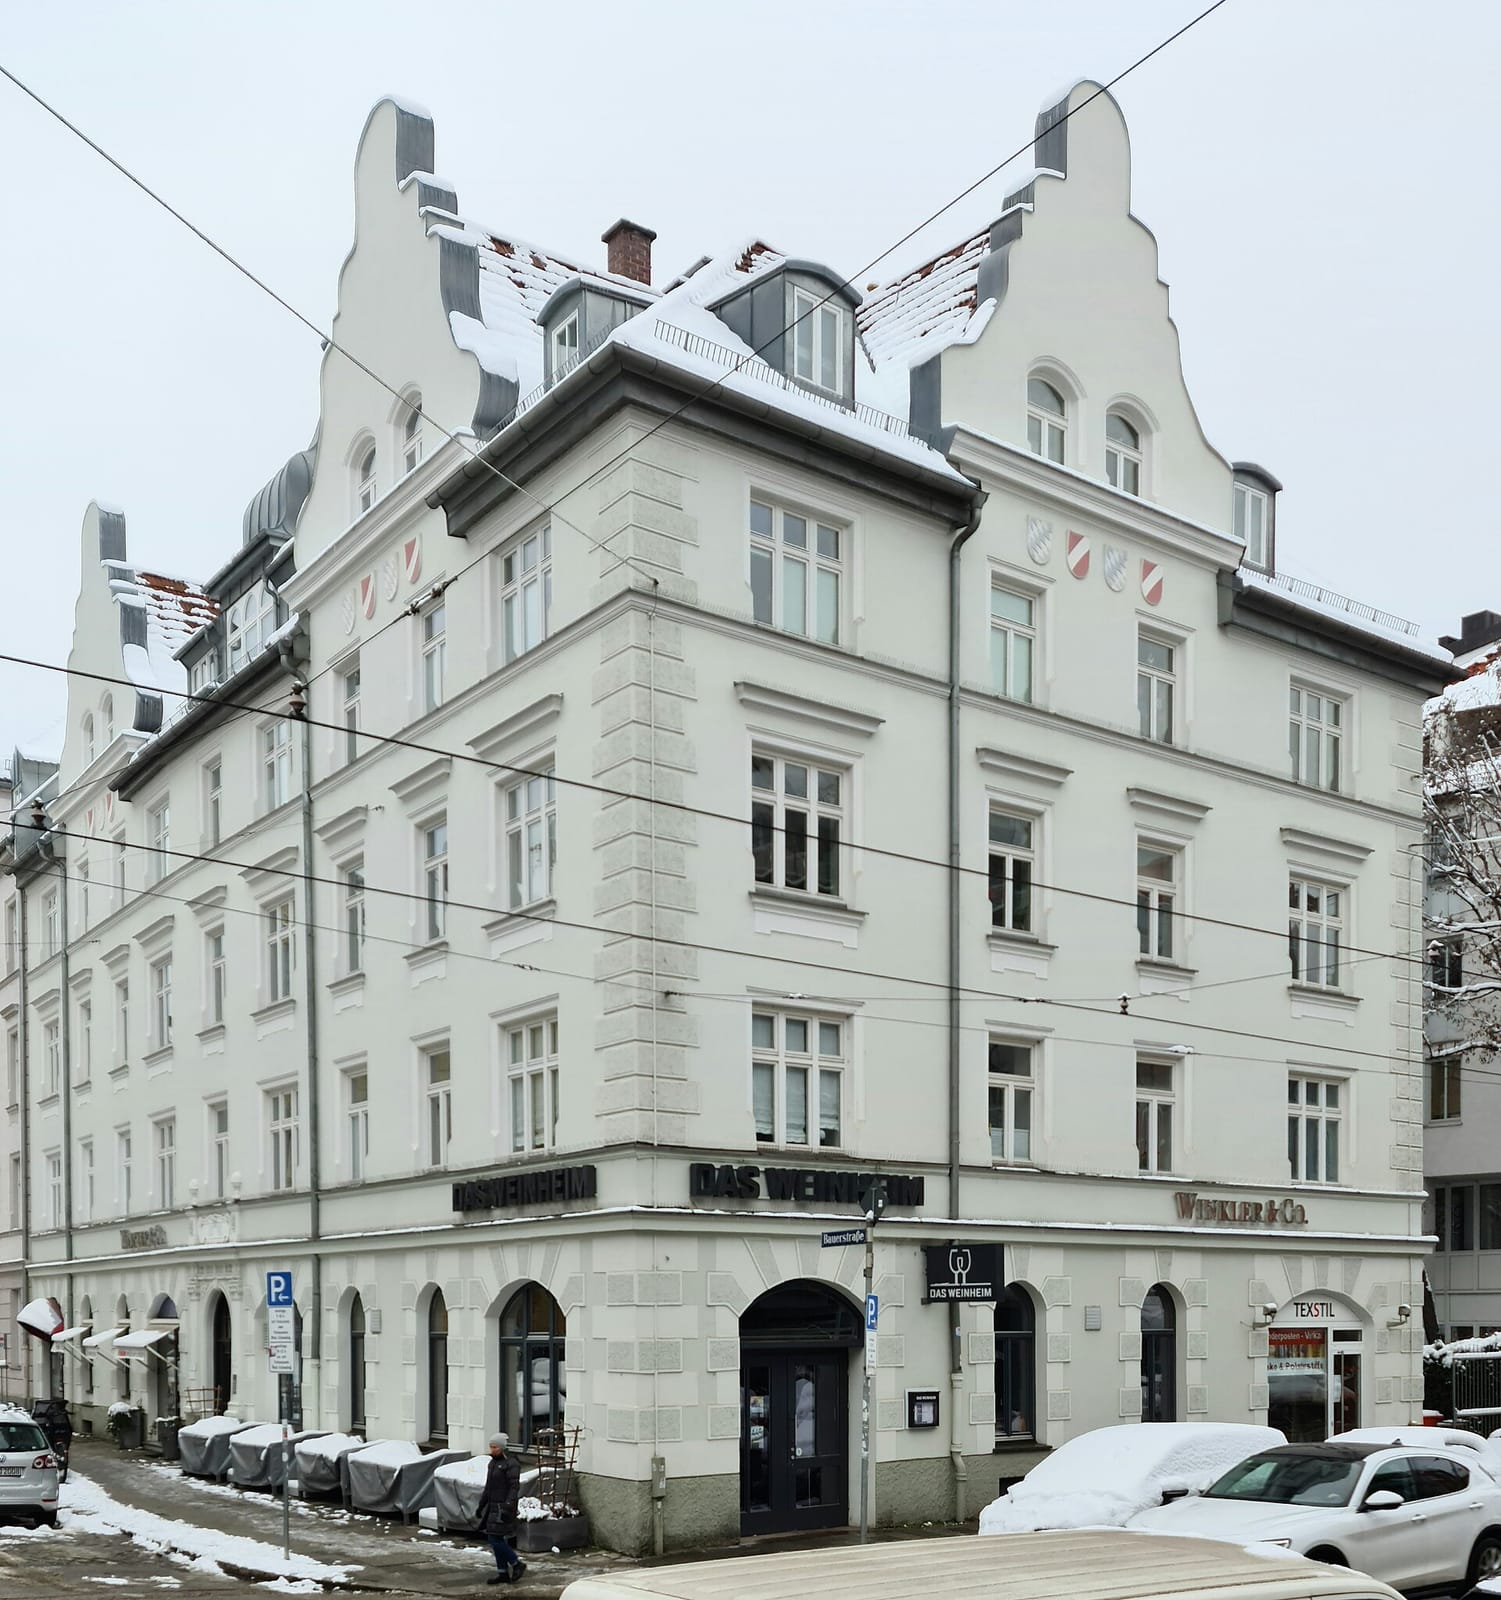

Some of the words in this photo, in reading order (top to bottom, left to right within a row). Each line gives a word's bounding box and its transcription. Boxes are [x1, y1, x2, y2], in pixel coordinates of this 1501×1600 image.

[690, 1163, 760, 1198] DAS
[823, 1230, 865, 1244] Bauerstraße
[930, 1288, 947, 1298] DAS
[948, 1287, 992, 1298] WEINHEIM
[1293, 1302, 1335, 1318] TEXSTIL
